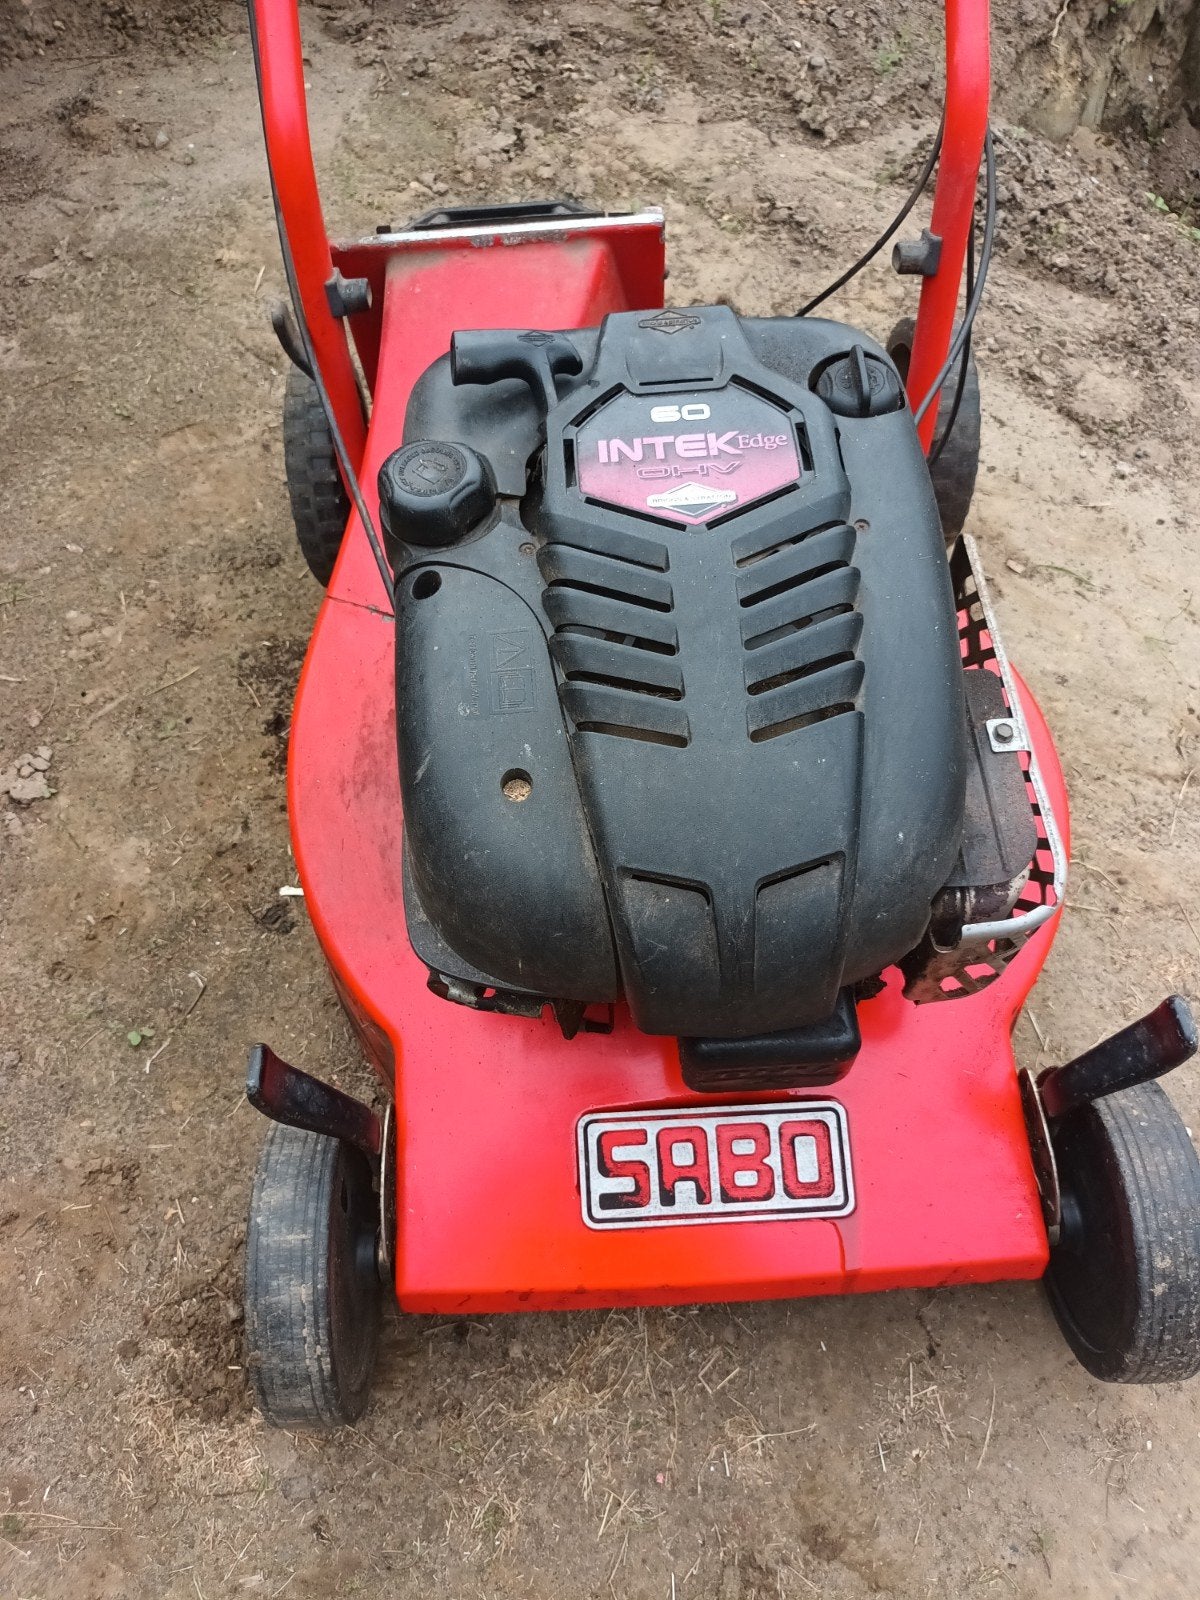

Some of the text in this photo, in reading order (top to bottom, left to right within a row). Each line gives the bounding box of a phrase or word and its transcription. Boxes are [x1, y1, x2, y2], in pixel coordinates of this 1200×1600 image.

[650, 403, 711, 423] 60
[597, 430, 788, 464] INTEK Edge
[636, 460, 742, 480] OHV
[597, 1118, 836, 1211] SABO
